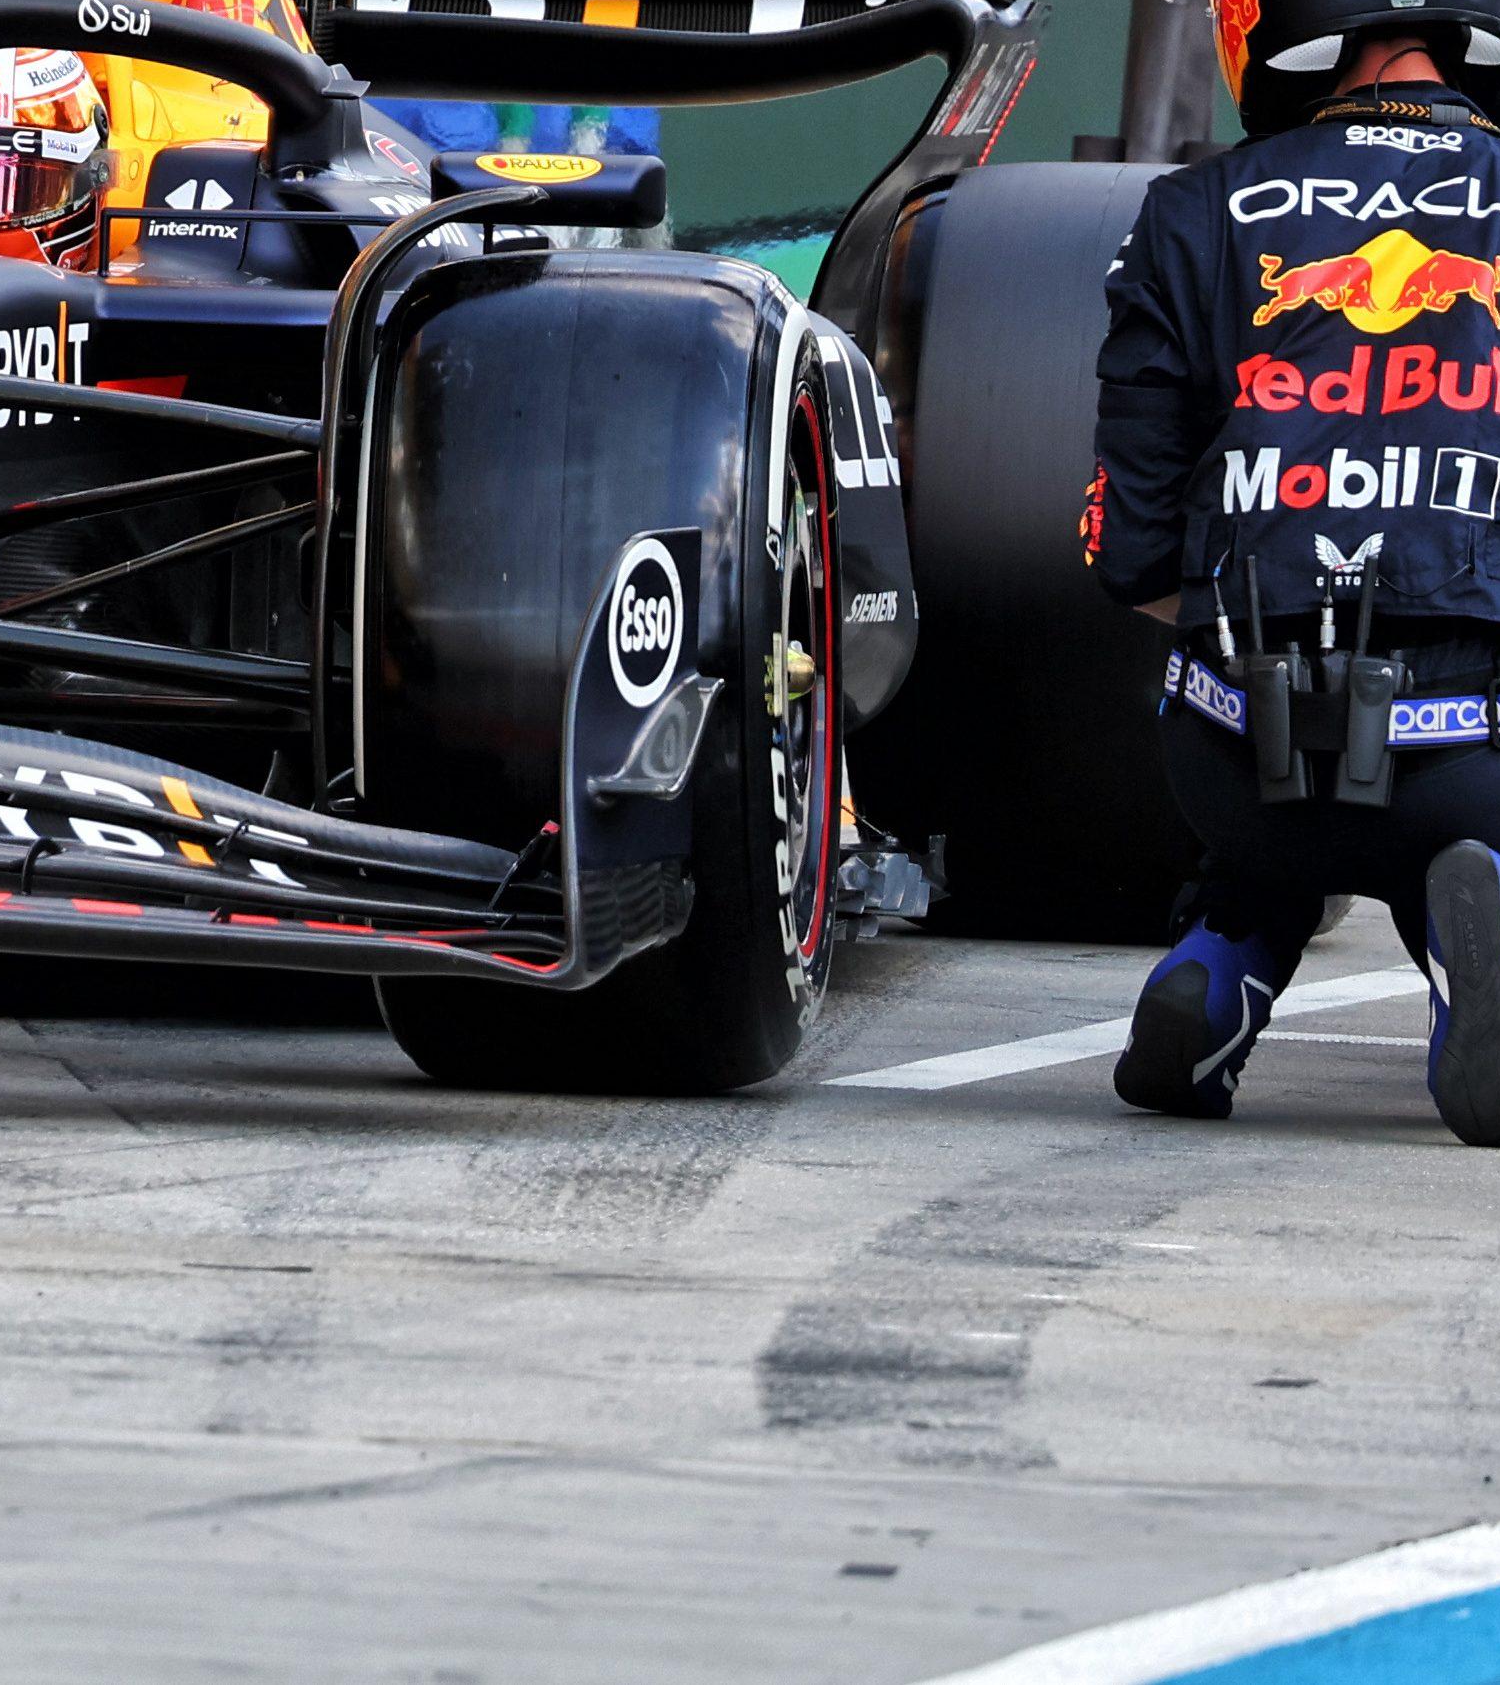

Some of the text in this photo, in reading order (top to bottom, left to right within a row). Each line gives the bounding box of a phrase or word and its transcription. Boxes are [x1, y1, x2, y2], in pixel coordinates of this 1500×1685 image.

[111, 4, 151, 37] Sui
[1345, 125, 1463, 153] sparco
[508, 157, 585, 171] RAUCH
[148, 219, 239, 240] inter.mx
[1223, 446, 1421, 514] Mobil
[845, 591, 897, 622] SIEMENS
